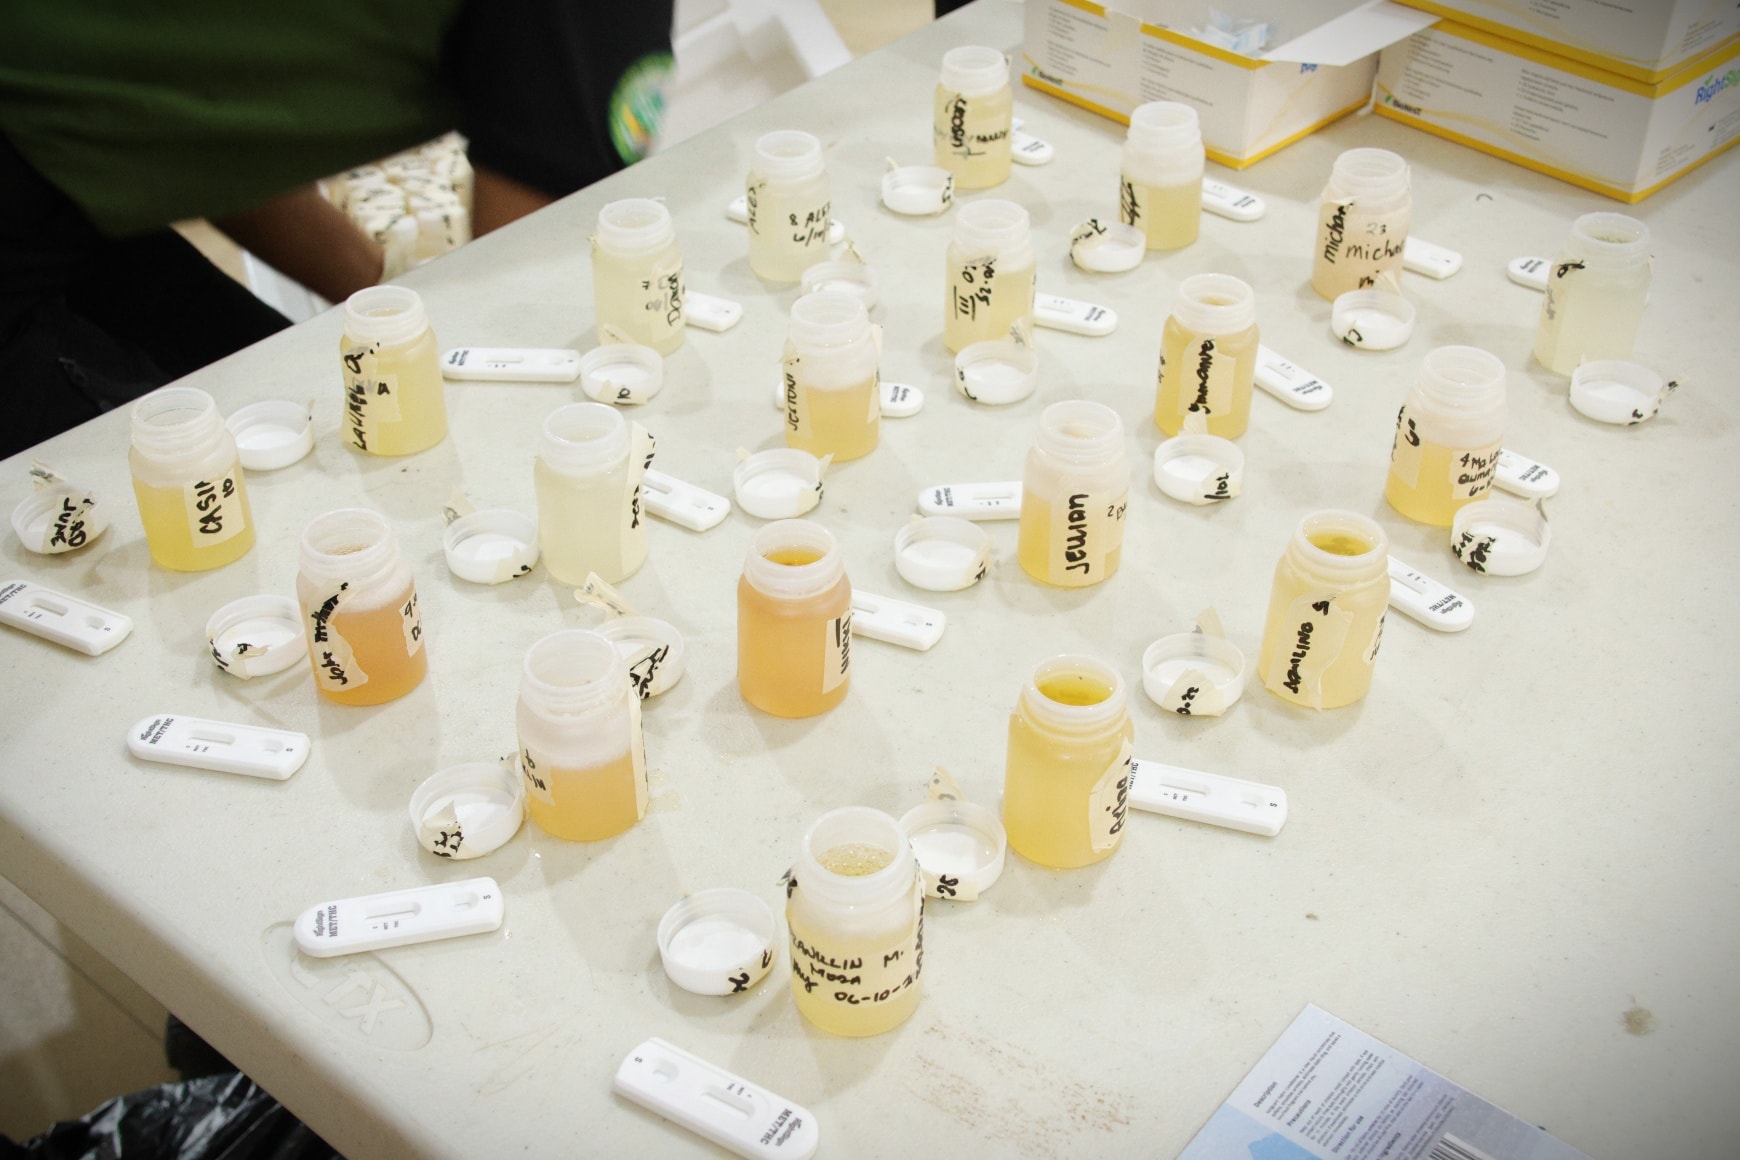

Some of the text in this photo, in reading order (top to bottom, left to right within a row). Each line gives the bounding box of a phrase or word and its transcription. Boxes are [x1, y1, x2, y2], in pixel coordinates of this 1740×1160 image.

[149, 716, 175, 745] MET/THC
[328, 904, 338, 938] MET/THC
[1252, 1080, 1279, 1108] Description
[759, 1108, 793, 1146] MET/THC
[1285, 1098, 1313, 1127] Precautions
[1329, 1114, 1365, 1153] Direction for use
